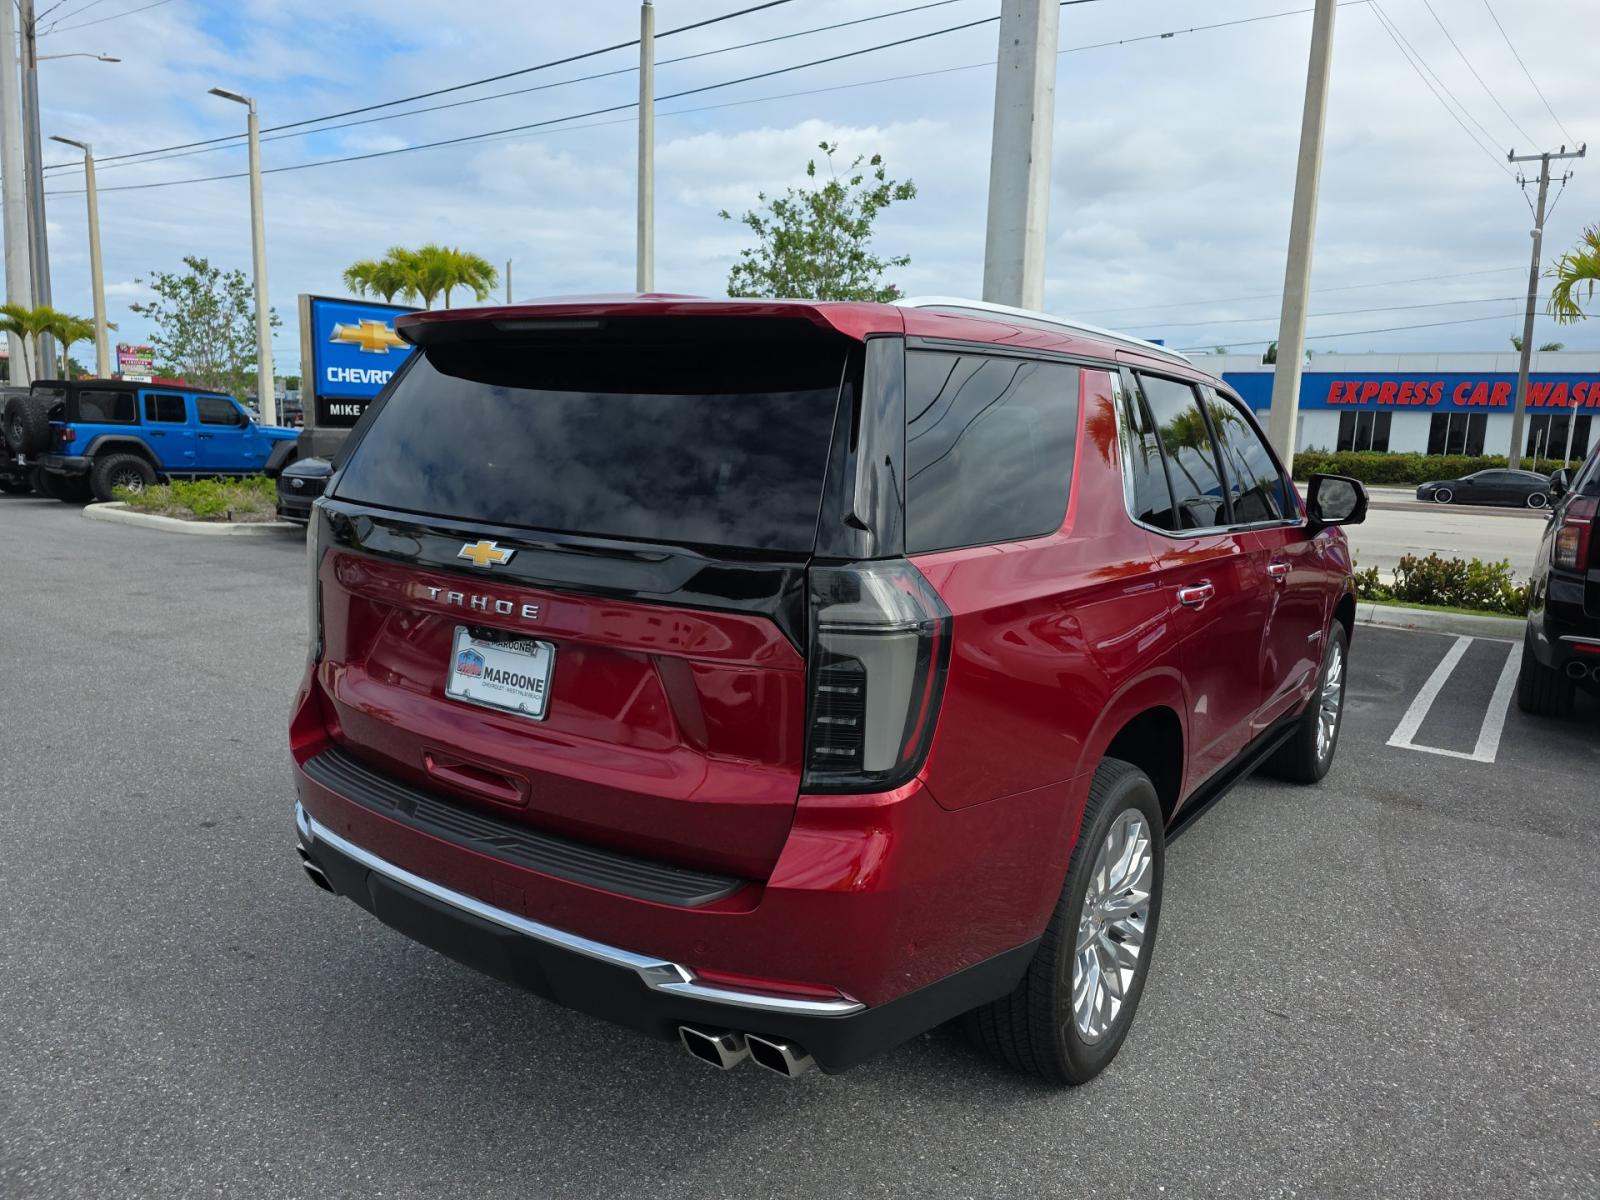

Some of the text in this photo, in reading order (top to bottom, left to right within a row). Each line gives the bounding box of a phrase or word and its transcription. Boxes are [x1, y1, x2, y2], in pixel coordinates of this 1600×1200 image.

[327, 366, 395, 385] CHEVRO
[1327, 381, 1444, 405] EXPRESS
[1453, 381, 1511, 406] CAR
[330, 404, 360, 416] MIKE
[427, 586, 539, 619] TAHOE
[483, 666, 544, 693] MAROONE
